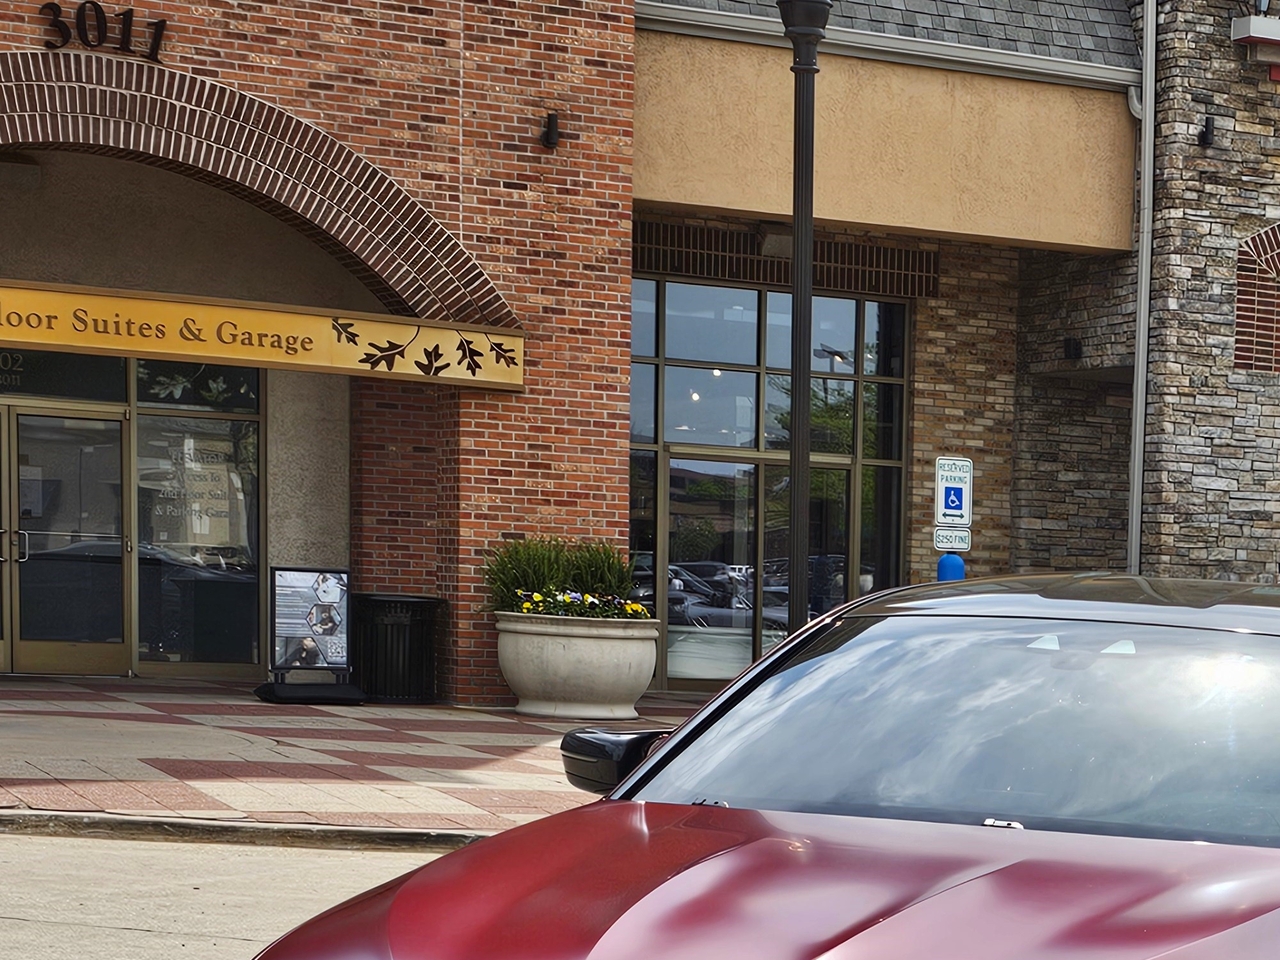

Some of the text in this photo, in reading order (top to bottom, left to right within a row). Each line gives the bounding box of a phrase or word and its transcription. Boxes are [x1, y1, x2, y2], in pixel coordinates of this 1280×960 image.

[39, 1, 167, 64] 3011
[71, 307, 166, 339] Suites
[178, 317, 207, 342] &
[216, 321, 314, 355] Garage
[939, 463, 970, 473] RESERVED
[940, 474, 967, 484] PARKING
[936, 534, 969, 545] $250 FINE
